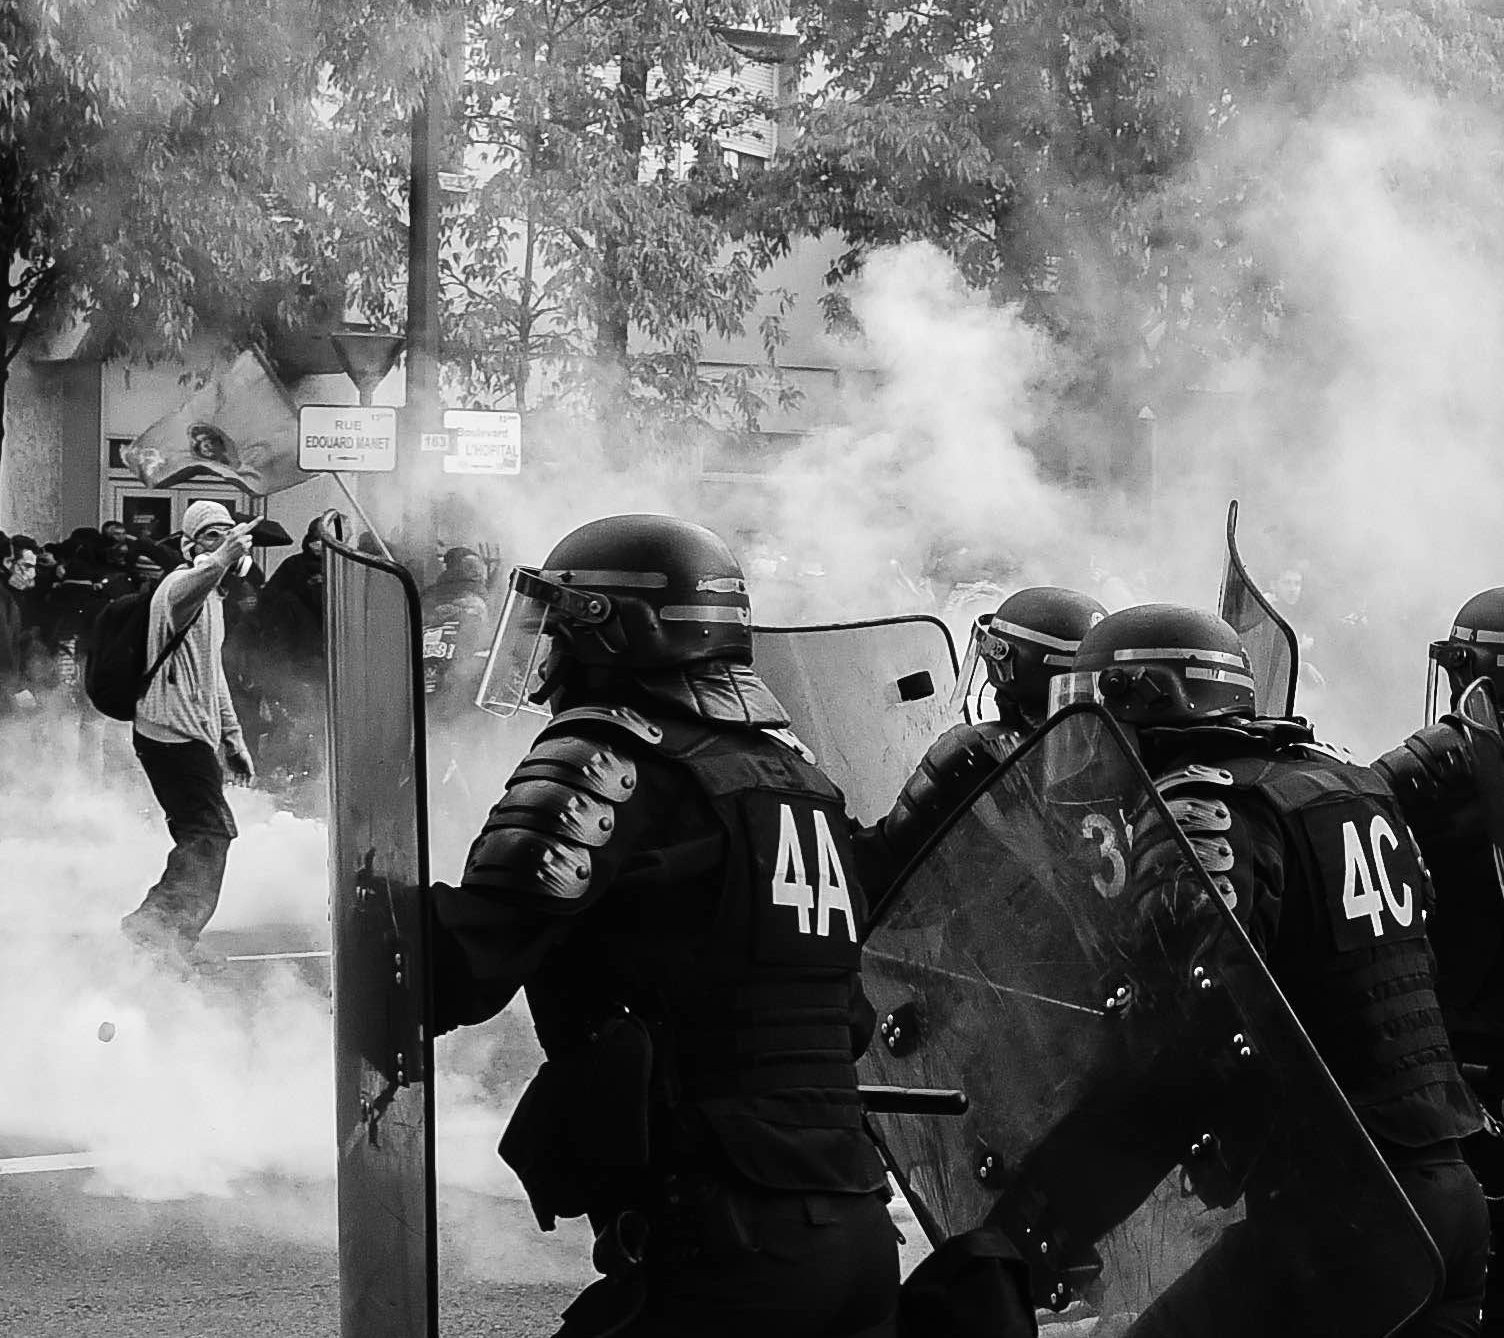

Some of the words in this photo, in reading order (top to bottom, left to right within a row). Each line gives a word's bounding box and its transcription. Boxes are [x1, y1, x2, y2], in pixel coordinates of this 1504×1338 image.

[305, 435, 354, 449] EDOUARD
[334, 419, 362, 431] RUE
[771, 803, 857, 942] 4A
[1341, 814, 1414, 938] 4C
